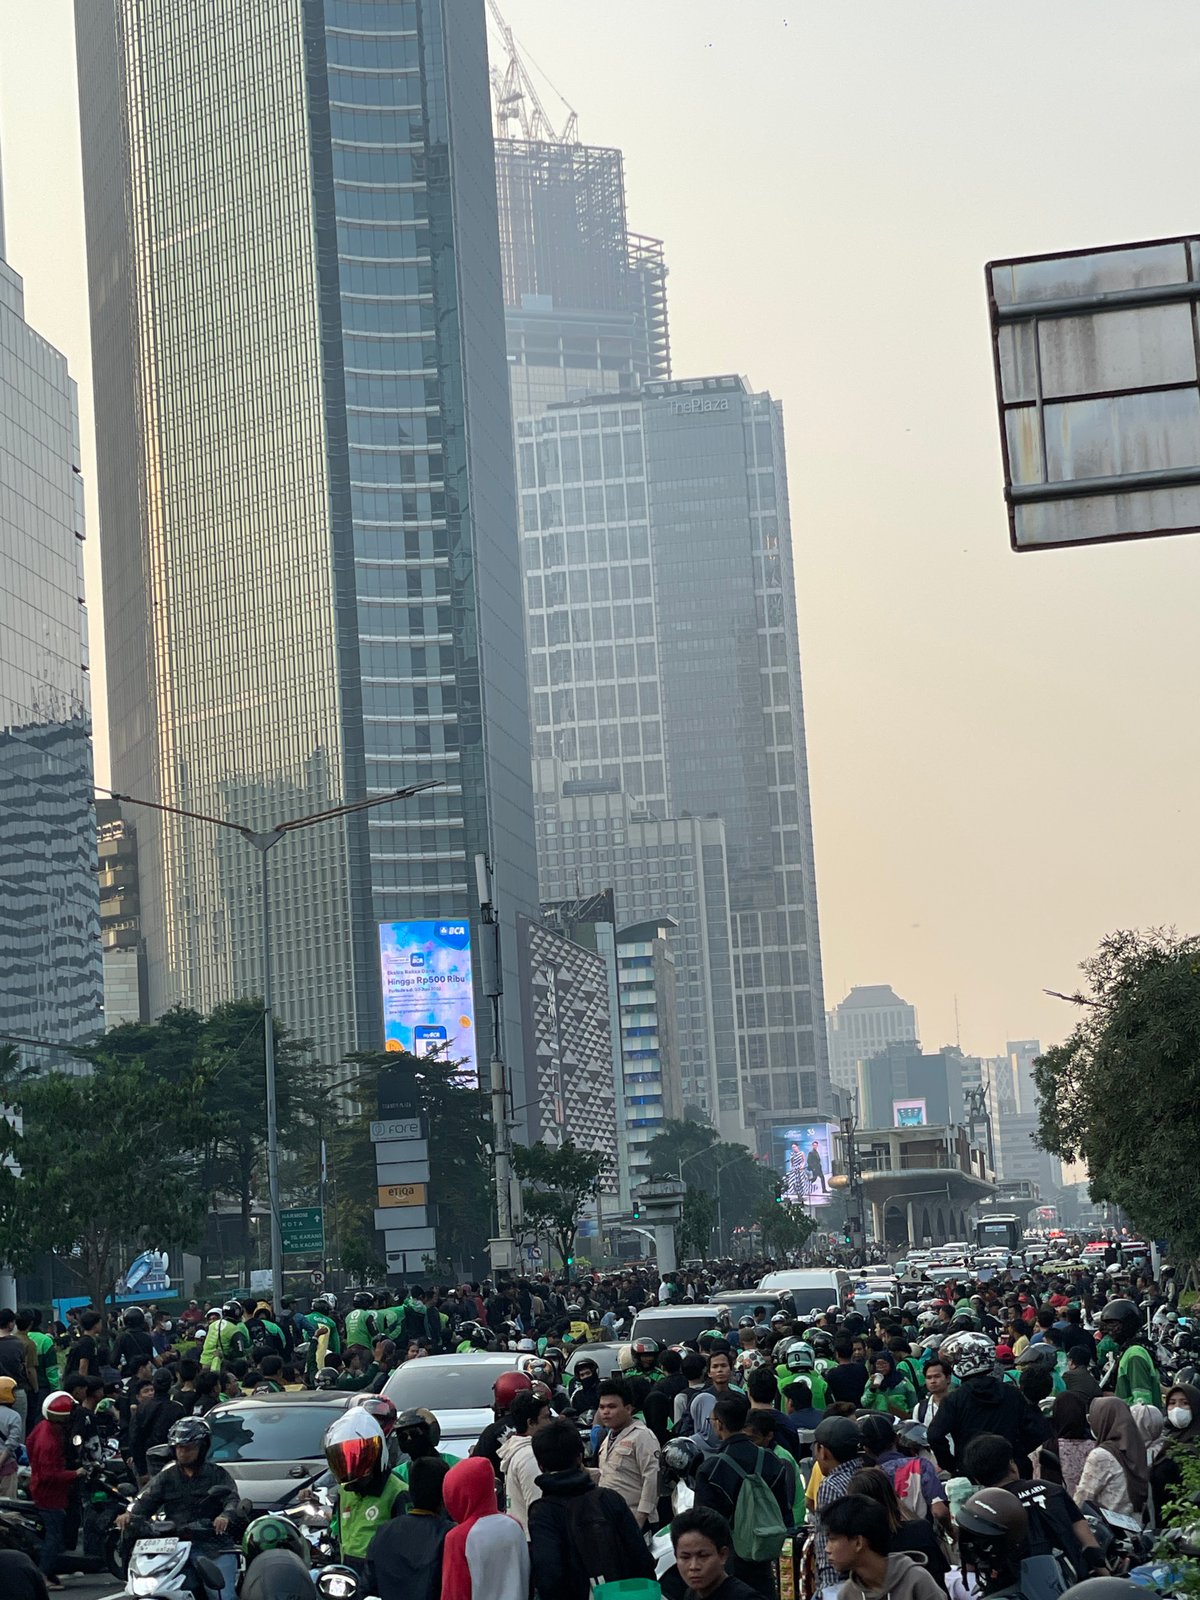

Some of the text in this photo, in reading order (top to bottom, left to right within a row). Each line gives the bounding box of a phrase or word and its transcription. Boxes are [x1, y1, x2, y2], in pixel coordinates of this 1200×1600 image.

[449, 926, 465, 935] BCA
[387, 975, 465, 986] Hingga Rp500 Ribu
[1018, 1485, 1047, 1499] JAKARTA
